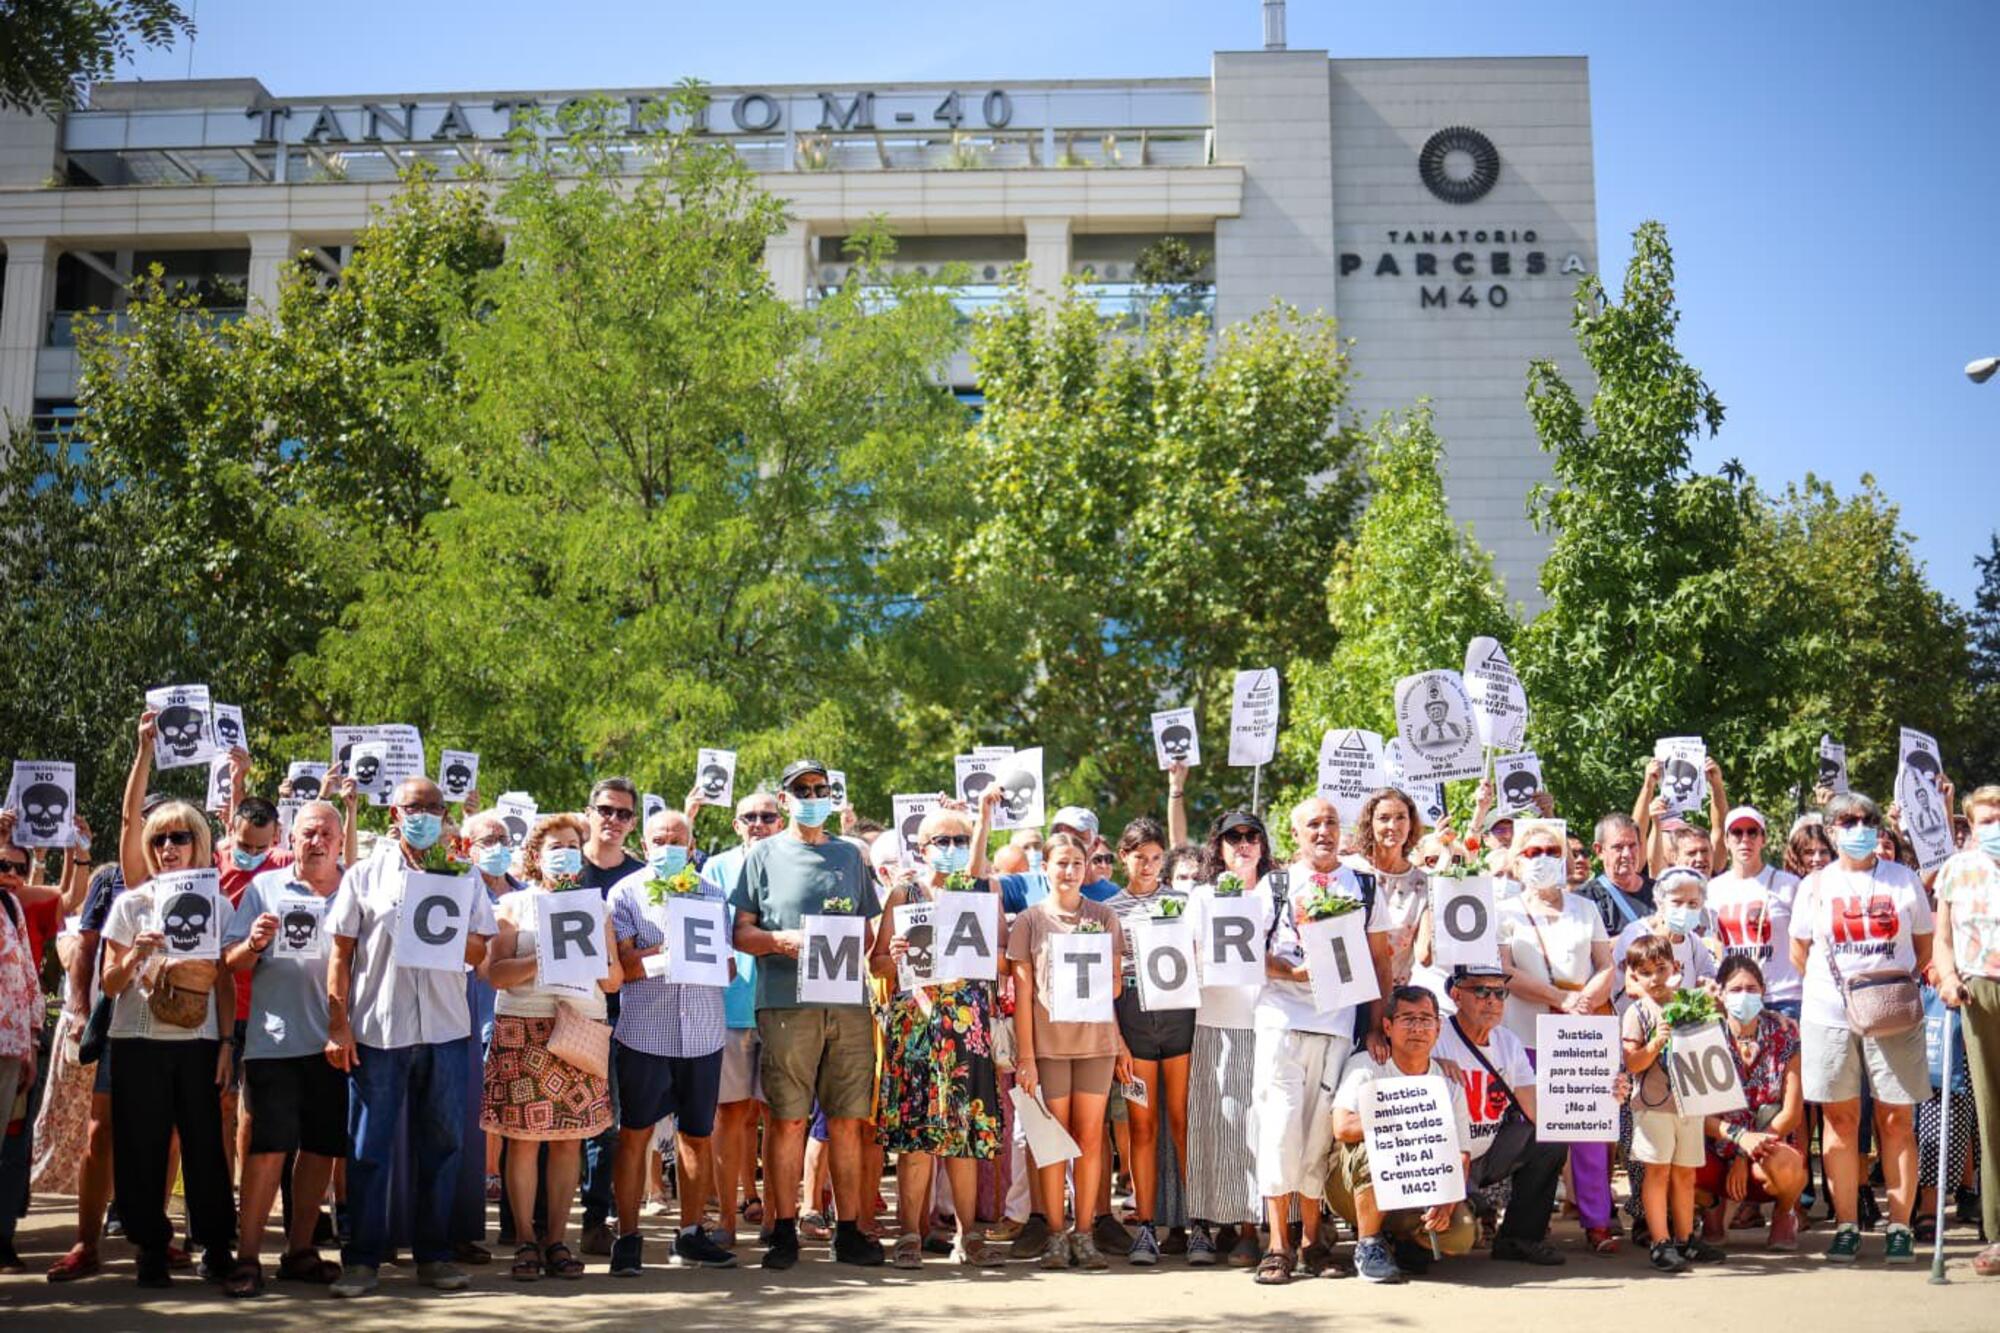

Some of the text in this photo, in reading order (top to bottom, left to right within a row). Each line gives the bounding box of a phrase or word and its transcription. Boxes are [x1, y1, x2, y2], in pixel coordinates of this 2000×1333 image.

[1388, 230, 1537, 244] TANATORIO
[1340, 251, 1586, 277] PARCESA
[1420, 284, 1509, 309] M40
[168, 696, 186, 706] NO
[971, 763, 986, 771] NO
[1510, 762, 1524, 771] NO
[35, 772, 54, 782] NO
[910, 804, 925, 813] NO
[175, 881, 194, 892] NO
[413, 895, 460, 945] C
[910, 914, 928, 925] NO
[1444, 895, 1488, 942] O
[1831, 894, 1900, 944] NO
[550, 910, 597, 960] R
[684, 917, 717, 964] E
[944, 911, 991, 957] A
[1212, 916, 1257, 963] R
[808, 935, 860, 981] M
[1331, 936, 1353, 984] I
[1064, 953, 1102, 999] T
[1147, 946, 1188, 991] O
[1557, 1029, 1603, 1040] Justicia
[1552, 1047, 1608, 1058] ambiental
[1550, 1066, 1610, 1078] para todos
[1673, 1046, 1735, 1097] NO
[1377, 1087, 1428, 1102] Justicia
[1549, 1083, 1611, 1094] los barrios.
[1375, 1100, 1437, 1119] ambiental
[1565, 1101, 1597, 1115] ¡No al
[1374, 1116, 1443, 1136] para todos
[1546, 1119, 1612, 1131] crematorio!
[1375, 1133, 1447, 1150] los barrios.
[1395, 1148, 1434, 1166] ¡No Al
[1380, 1163, 1454, 1181] Crematorio
[1402, 1180, 1437, 1195] M40!
